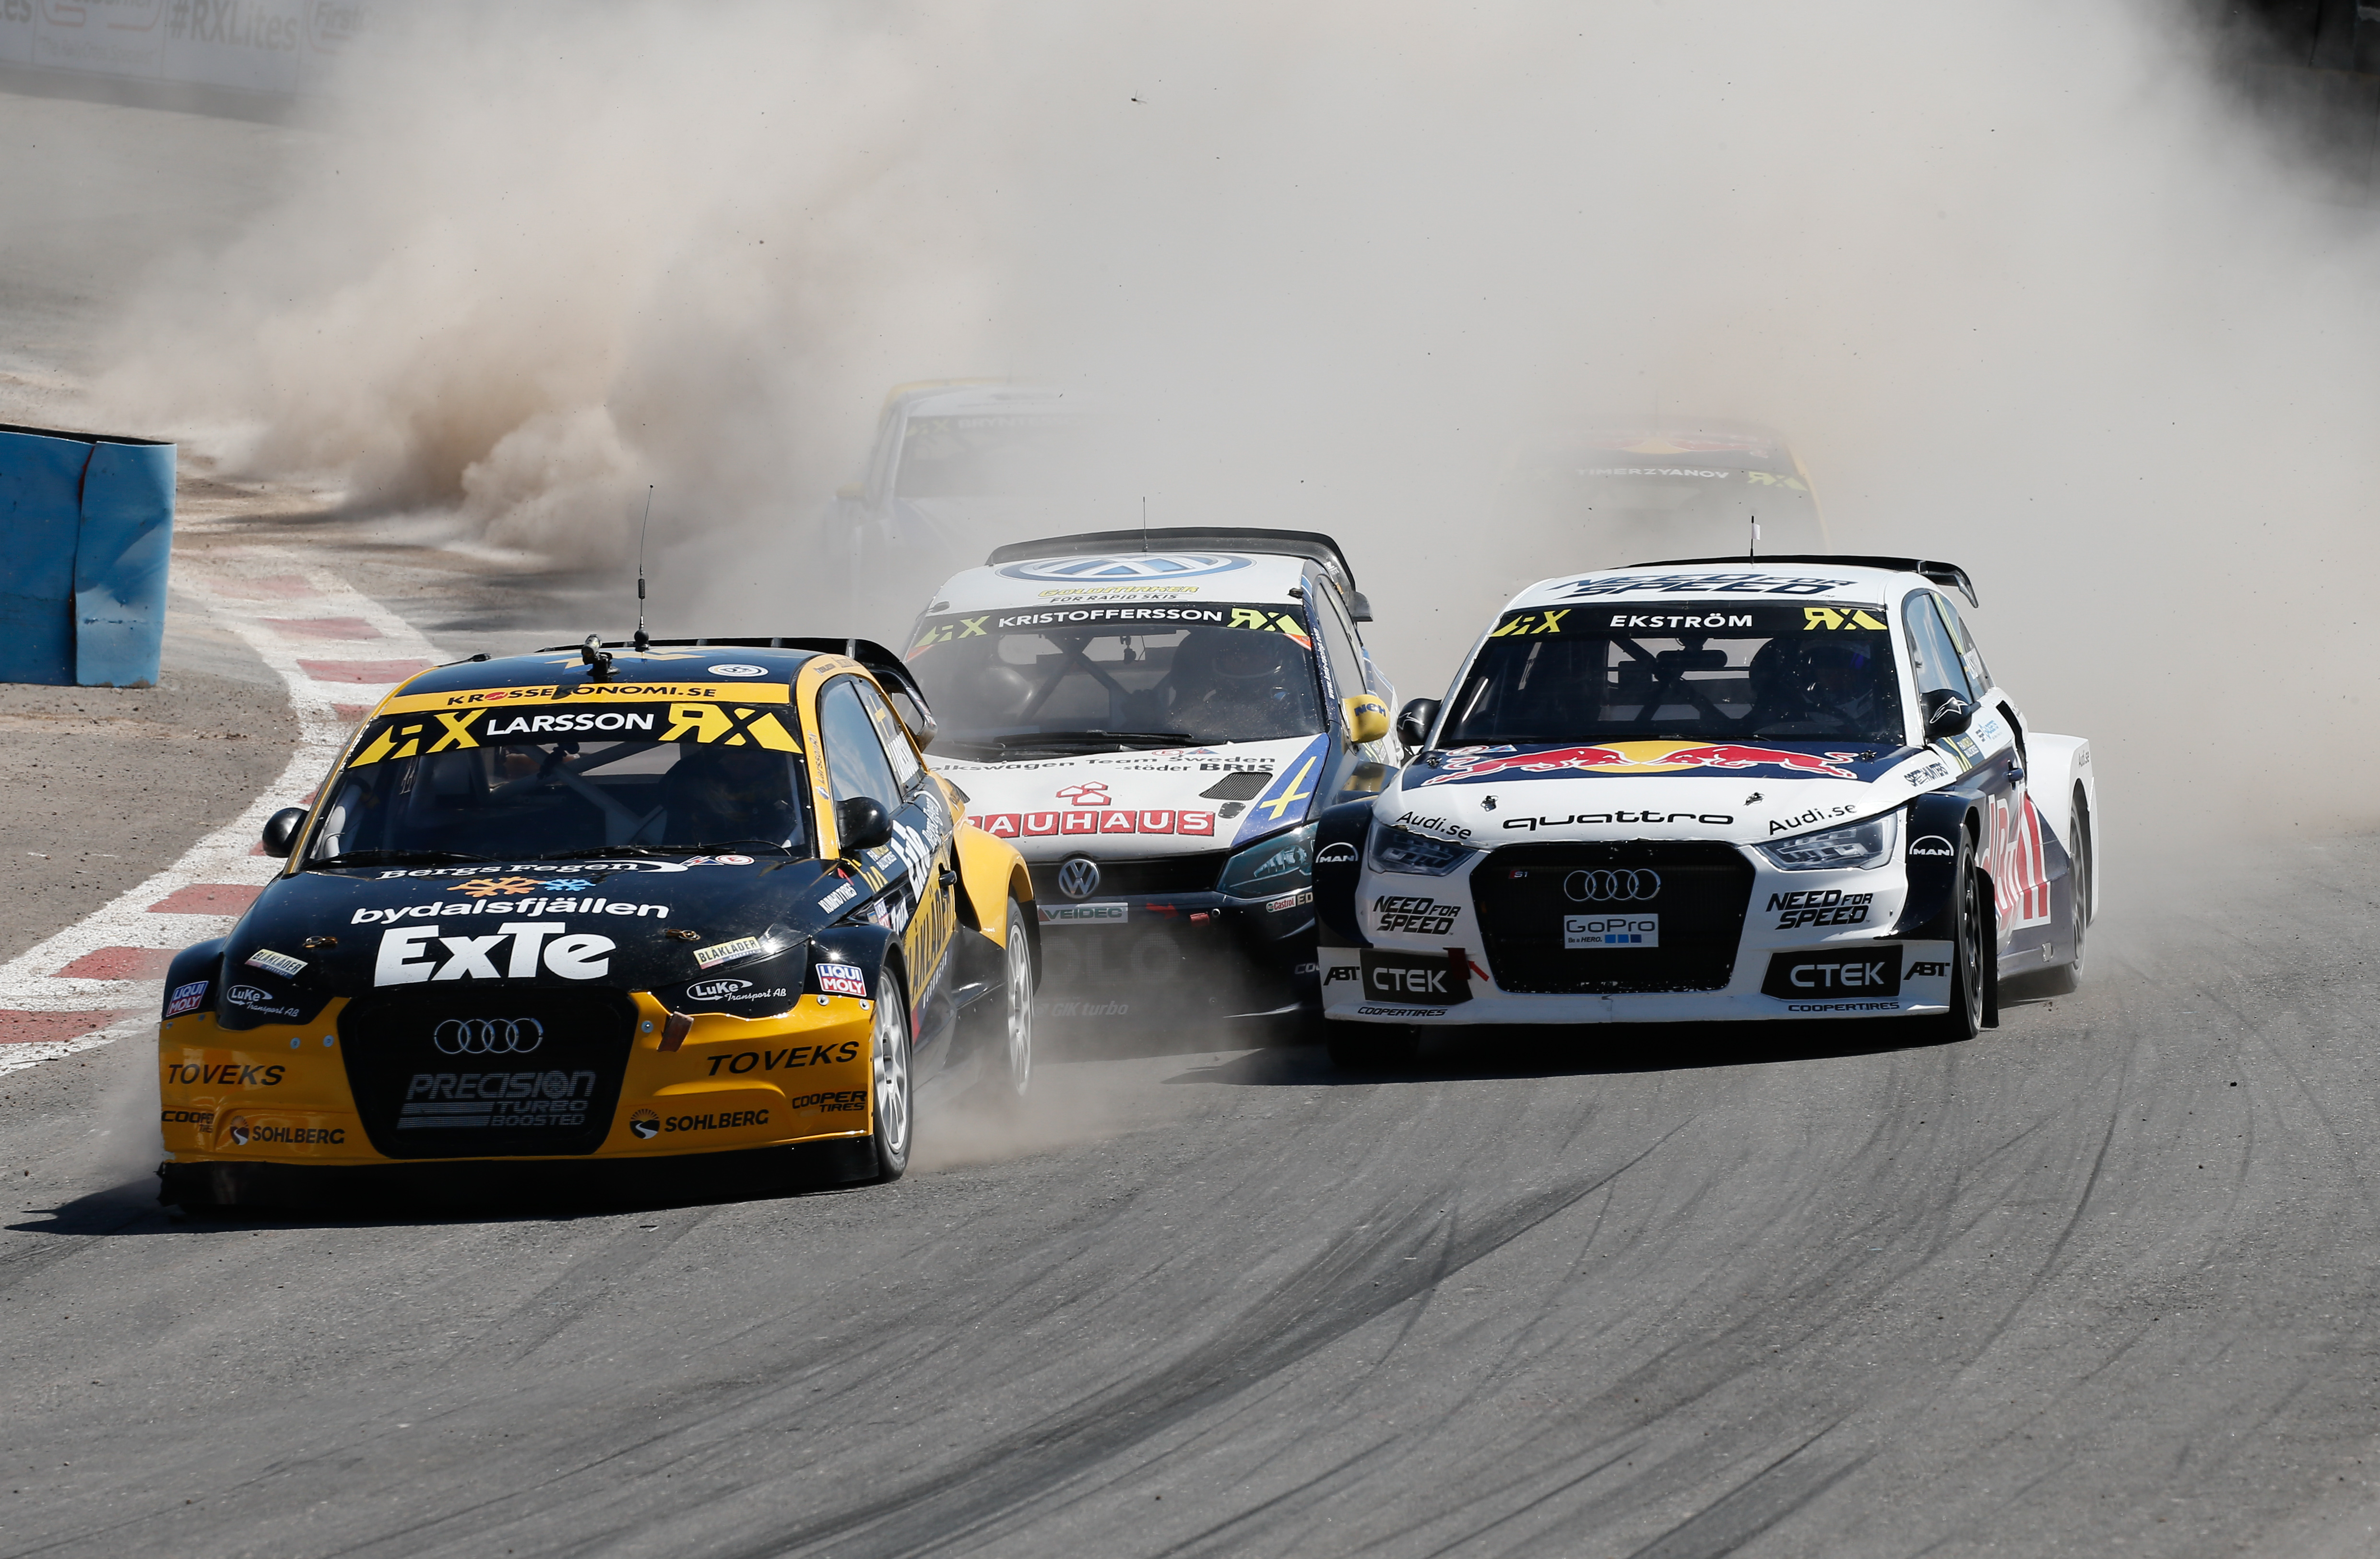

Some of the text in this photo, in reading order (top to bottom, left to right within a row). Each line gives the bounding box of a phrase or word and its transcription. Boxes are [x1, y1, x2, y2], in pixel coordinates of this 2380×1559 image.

[0, 0, 33, 23] es
[1576, 468, 1729, 479] TIMERZYANOV
[1038, 586, 1200, 597] GOLDMAKER
[1545, 573, 1859, 592] NEED FOR
[1553, 582, 1837, 600] SPEED
[1050, 595, 1081, 604] FOR
[998, 608, 1222, 629] KRISTOFFERSSON
[1610, 613, 1752, 628] EKSTRÖM
[486, 713, 654, 736] LARSSON
[929, 760, 1075, 772] olkswagen
[1168, 756, 1276, 764] Sweden
[1199, 763, 1274, 772] BRIS
[1396, 810, 1472, 840] Audi.se
[1503, 810, 1734, 832] quattro
[1769, 804, 1858, 835] Audi.se
[375, 862, 639, 880] Bergs Fegen
[1274, 892, 1314, 910] Castrol ED
[1373, 895, 1461, 918] NEED FOR
[1766, 889, 1873, 912] NEED FOR
[350, 898, 670, 924] bydalsfjällen
[1045, 907, 1123, 919] VEIDEC
[1775, 904, 1870, 930] SPEED
[1376, 912, 1455, 935] SPEED
[1566, 918, 1656, 933] GoPro
[374, 922, 617, 987] ExTe
[698, 939, 758, 963] BLÅKLÄDER
[252, 952, 302, 974] BLÅKLÄDER
[1294, 962, 1320, 975] CO
[1903, 961, 1951, 981] ABT
[820, 965, 860, 981] LIQUI
[1323, 966, 1360, 986] ABT
[1373, 967, 1447, 993] CTEK
[1790, 962, 1885, 987] CTEK
[173, 983, 206, 1001] LIQUI
[232, 987, 260, 1001] LuKe
[695, 981, 739, 996] LuKe
[724, 988, 787, 1001] Transport AB
[822, 977, 864, 994] MOLY
[168, 994, 202, 1015] MOLY
[246, 1001, 300, 1017] Transport AB
[1082, 1000, 1129, 1016] turbo
[707, 1041, 860, 1076] TOVEKS
[167, 1063, 286, 1086] TOVEKS
[406, 1070, 596, 1100] PRECISION
[492, 1100, 588, 1114] TURBO
[792, 1090, 867, 1109] COOPER
[819, 1102, 865, 1113] TIRES
[490, 1114, 585, 1127] BOOSTED
[664, 1109, 770, 1132] SOHLBERG
[252, 1125, 345, 1144] SOHLBERG
